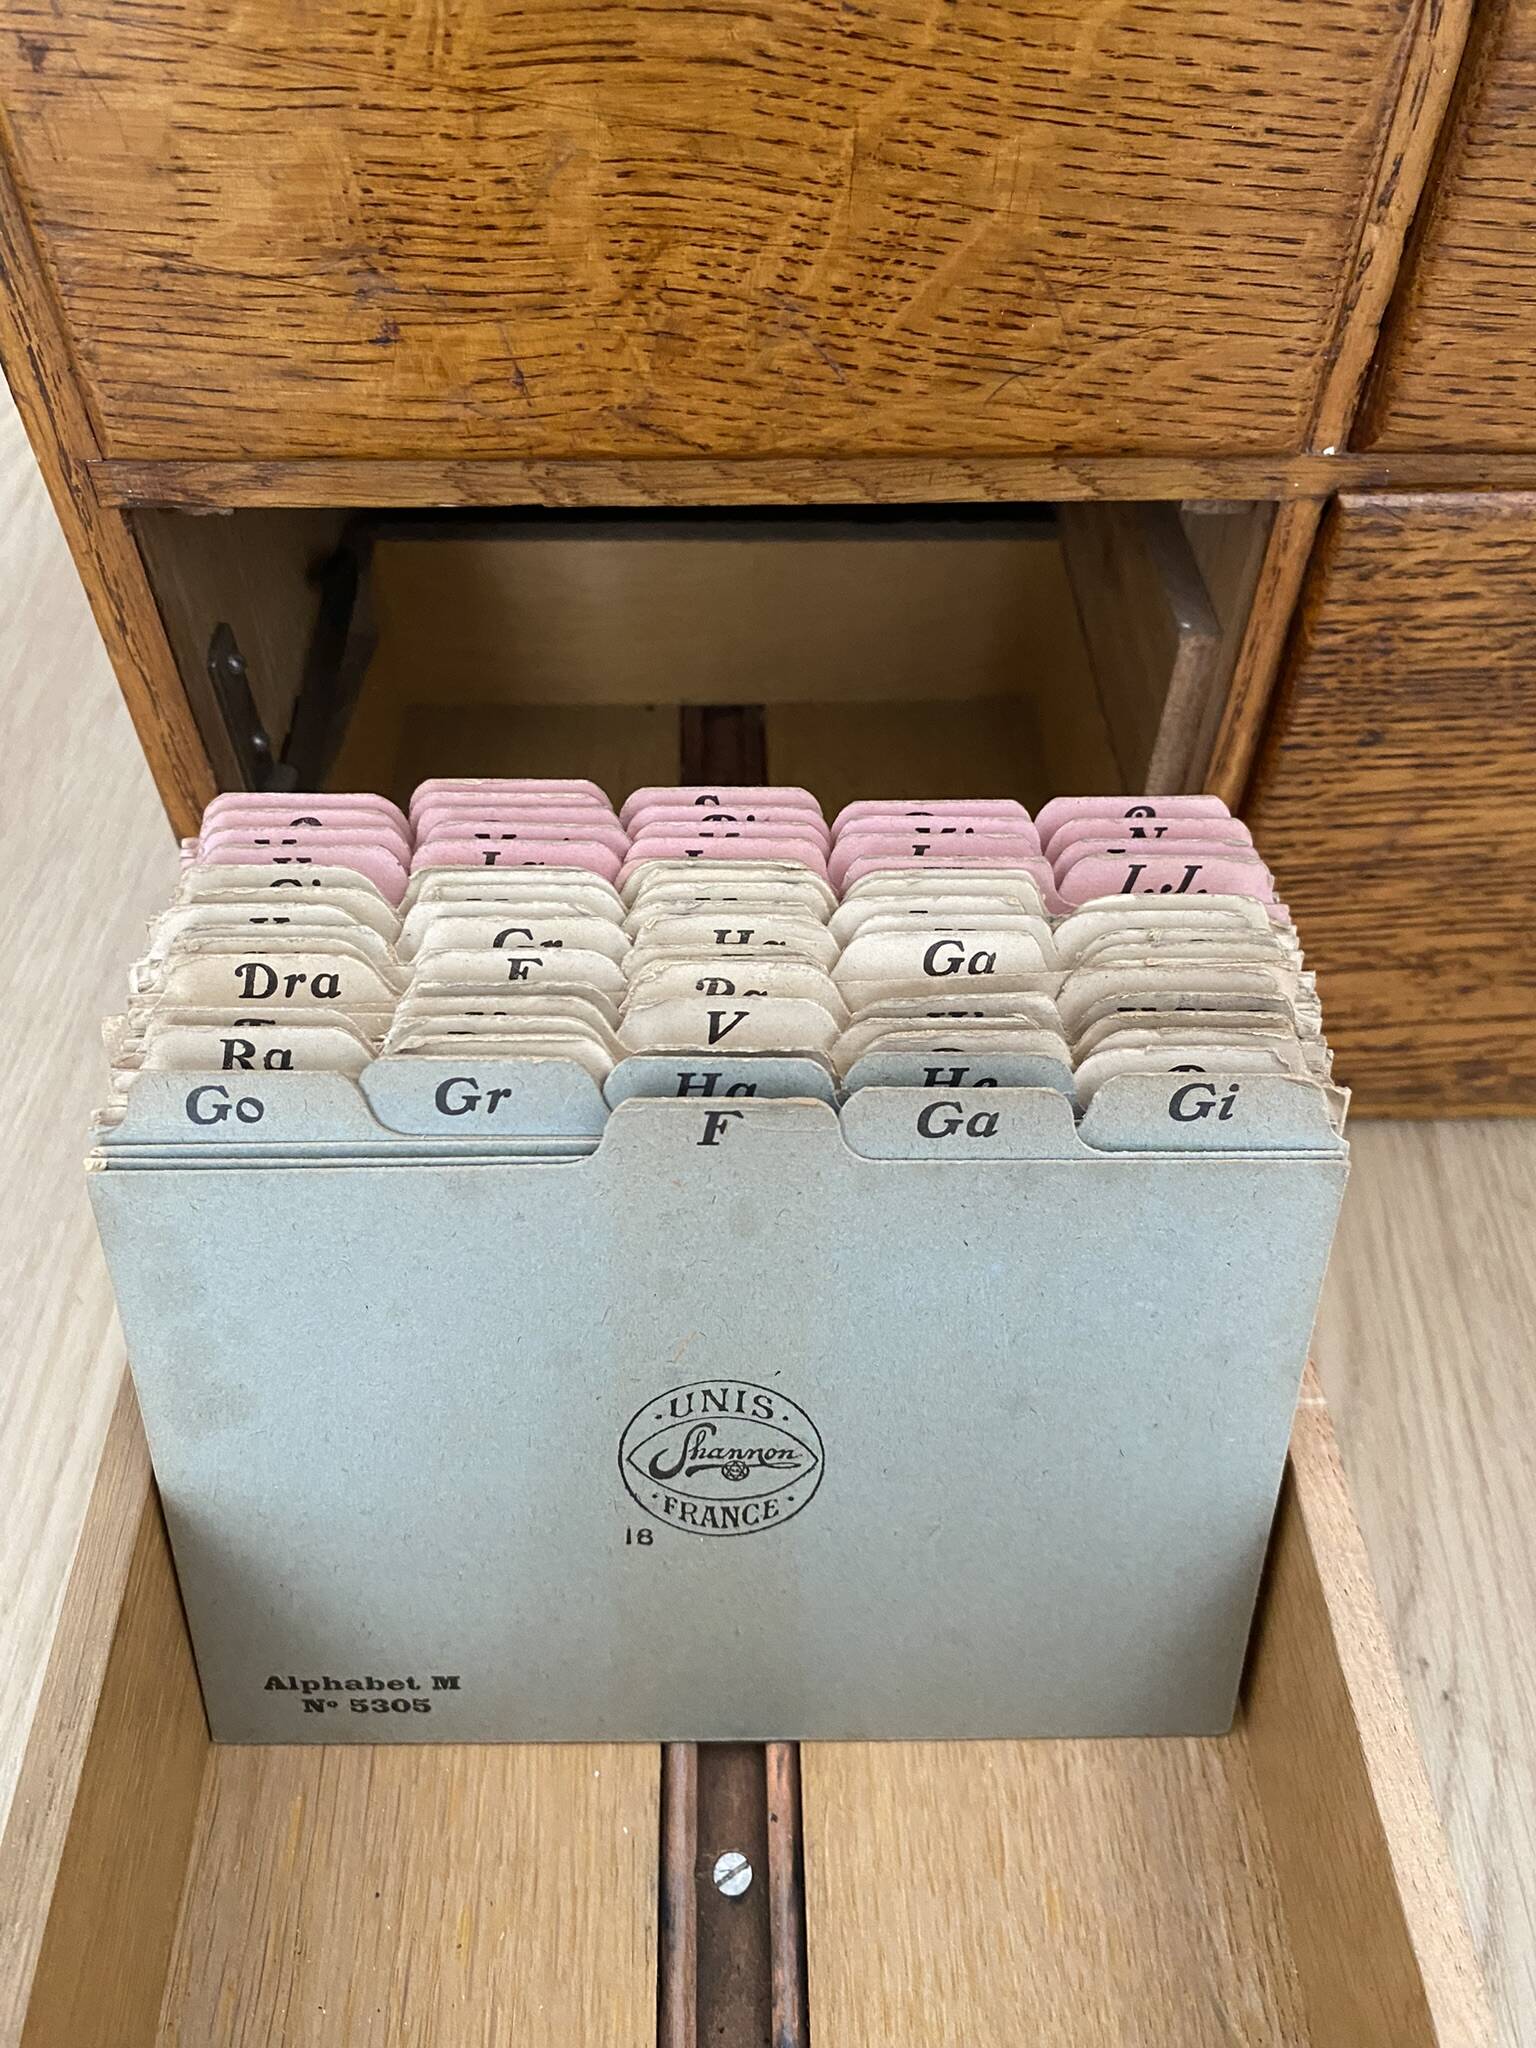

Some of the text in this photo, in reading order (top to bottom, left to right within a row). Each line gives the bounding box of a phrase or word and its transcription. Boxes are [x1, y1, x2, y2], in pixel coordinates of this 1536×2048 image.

[923, 940, 997, 977] Ga
[234, 962, 341, 999] Dra
[707, 1011, 750, 1045] V
[220, 1038, 294, 1070] Ra
[185, 1085, 265, 1125] Go
[435, 1077, 512, 1116] Gr
[1168, 1082, 1240, 1122] Gi
[697, 1110, 744, 1146] F
[917, 1101, 1000, 1138] Ga
[669, 1387, 775, 1420] UNIS
[648, 1422, 802, 1480] Shannon
[663, 1494, 780, 1529] FRANCE
[626, 1526, 654, 1546] 18
[264, 1675, 461, 1694] Alphabet M
[350, 1698, 431, 1713] 5305
